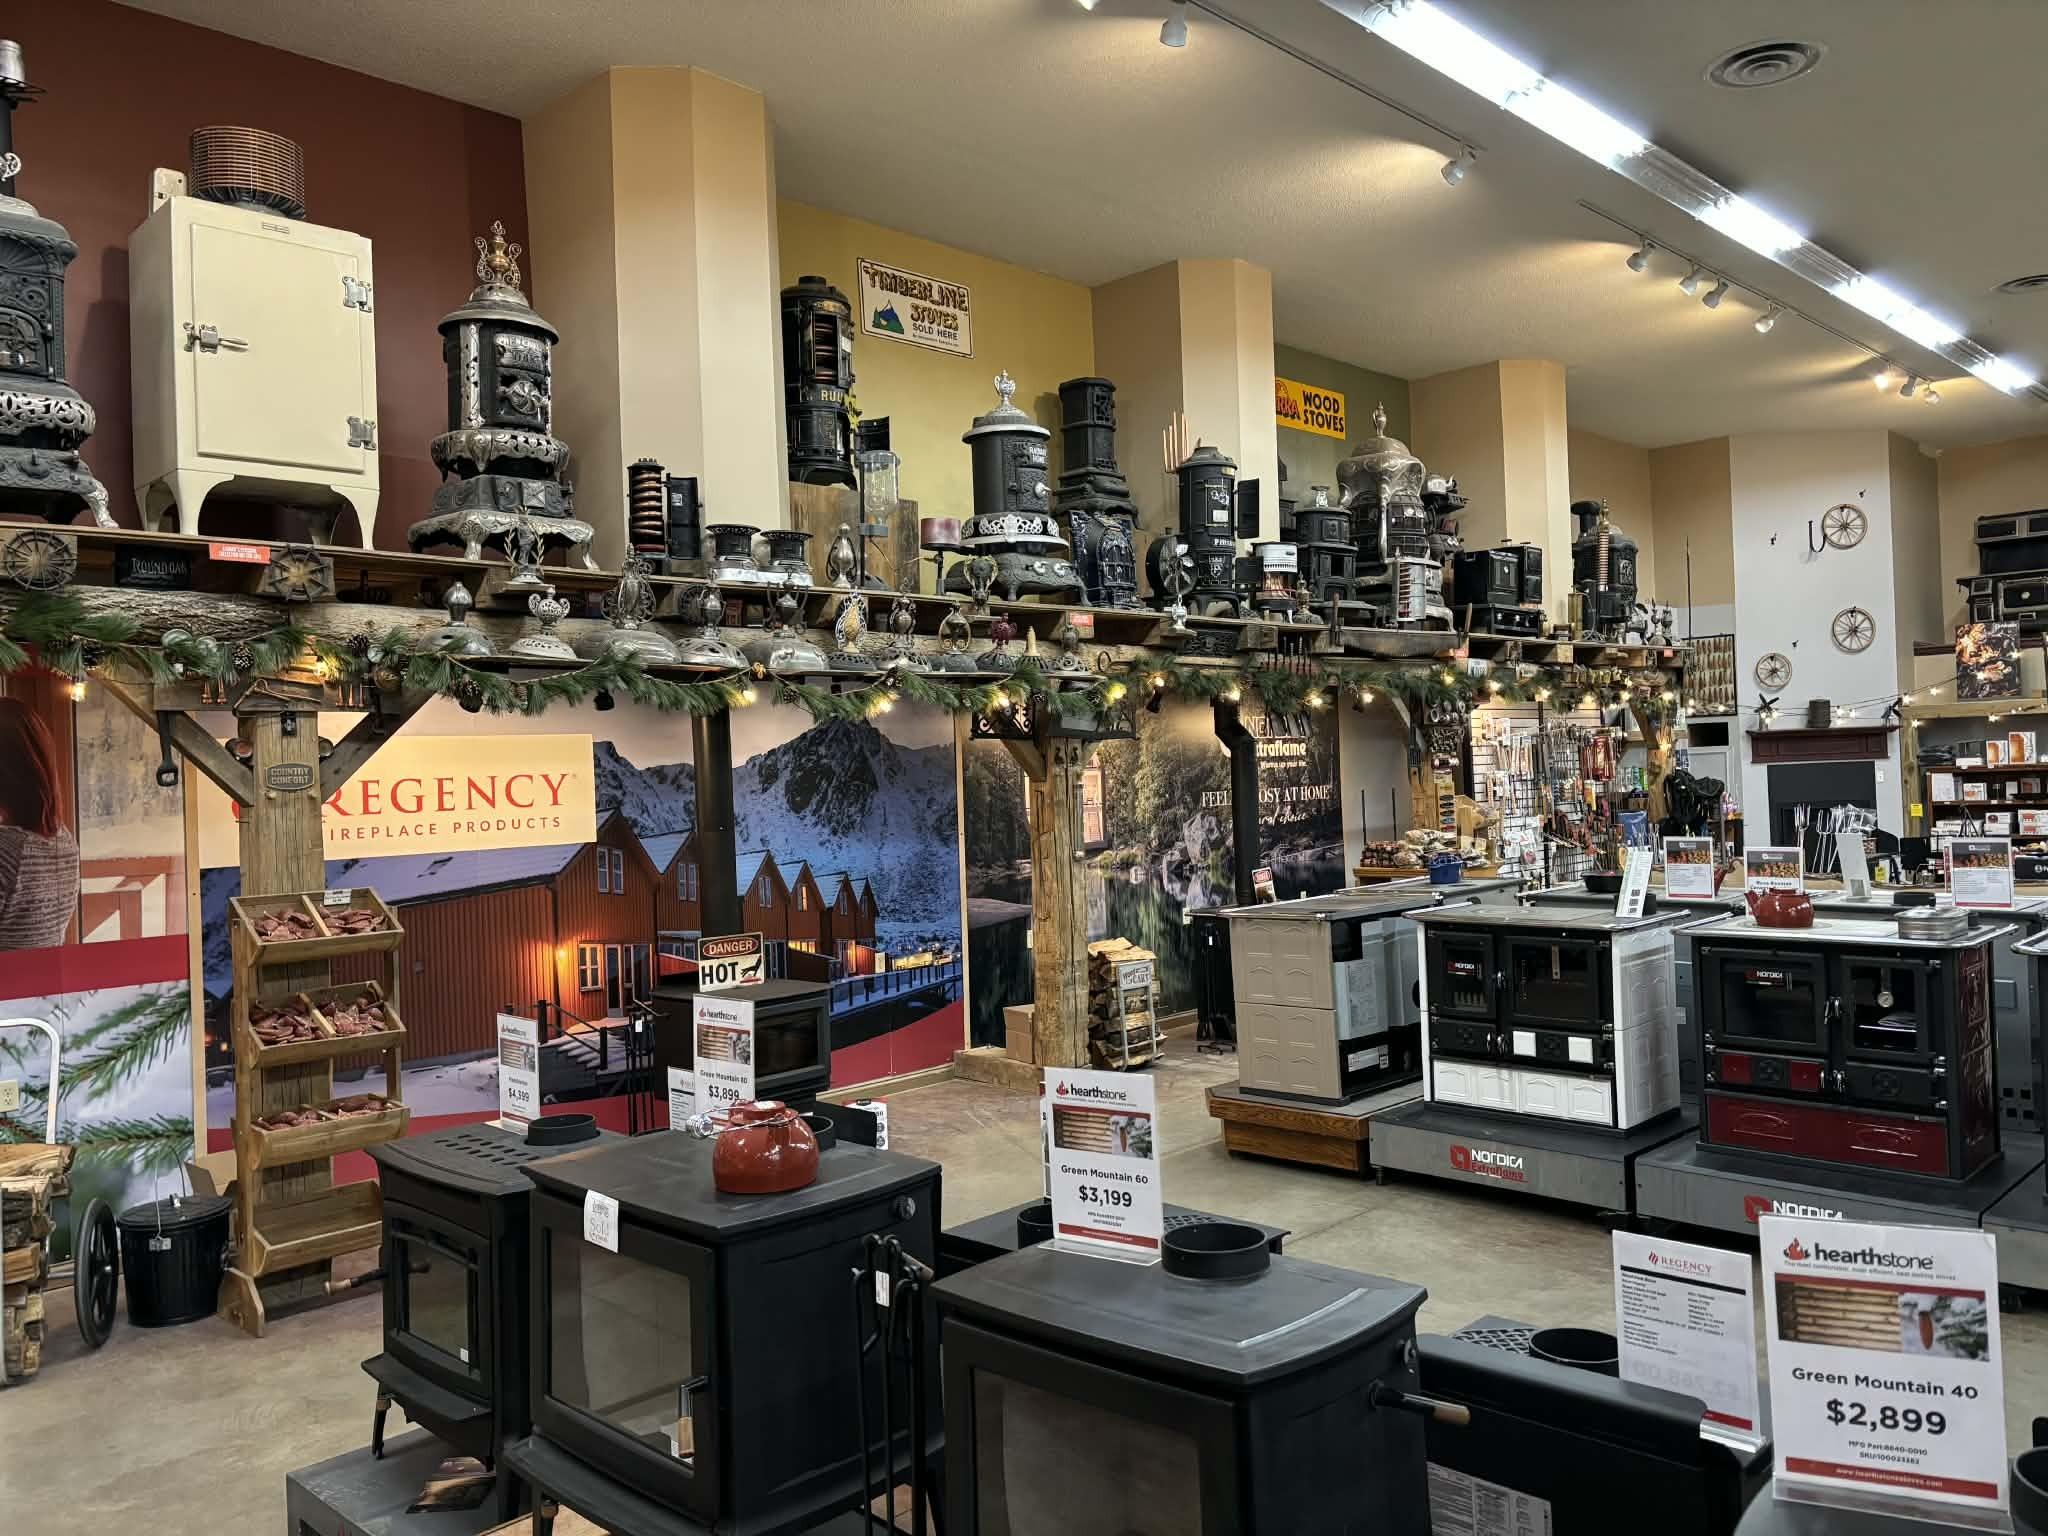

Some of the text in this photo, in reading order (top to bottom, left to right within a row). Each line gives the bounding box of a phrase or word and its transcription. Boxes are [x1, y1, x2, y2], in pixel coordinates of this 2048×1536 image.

[863, 265, 968, 312] TIMBERLINE
[910, 302, 959, 331] STOVES
[912, 322, 934, 335] SOLD
[937, 329, 958, 341] HERE
[1303, 390, 1340, 414] WOOD
[1304, 409, 1344, 433] STOVES
[1256, 739, 1306, 757] traflame
[321, 773, 569, 818] REGENCY
[1258, 788, 1281, 803] OSY
[1283, 786, 1298, 802] AT
[1301, 785, 1330, 801] HOME
[330, 816, 561, 841] IREPLACE PRODUCTS
[708, 940, 753, 955] DANGER
[701, 962, 739, 985] HOT
[706, 1009, 738, 1022] hearthstone
[700, 1069, 715, 1079] Green
[716, 1071, 740, 1083] Mountain
[708, 1084, 740, 1100] $3,899
[1070, 1083, 1127, 1100] hearthstone
[1471, 1148, 1523, 1168] NORDICA
[1061, 1164, 1149, 1184] Green Mountain 60
[1078, 1184, 1133, 1208] $3,199
[1661, 1256, 1713, 1274] REGENCY
[1814, 1242, 1934, 1270] hearthstone
[1792, 1367, 1979, 1400] Green Mountain 40
[1826, 1398, 1947, 1435] $2,899
